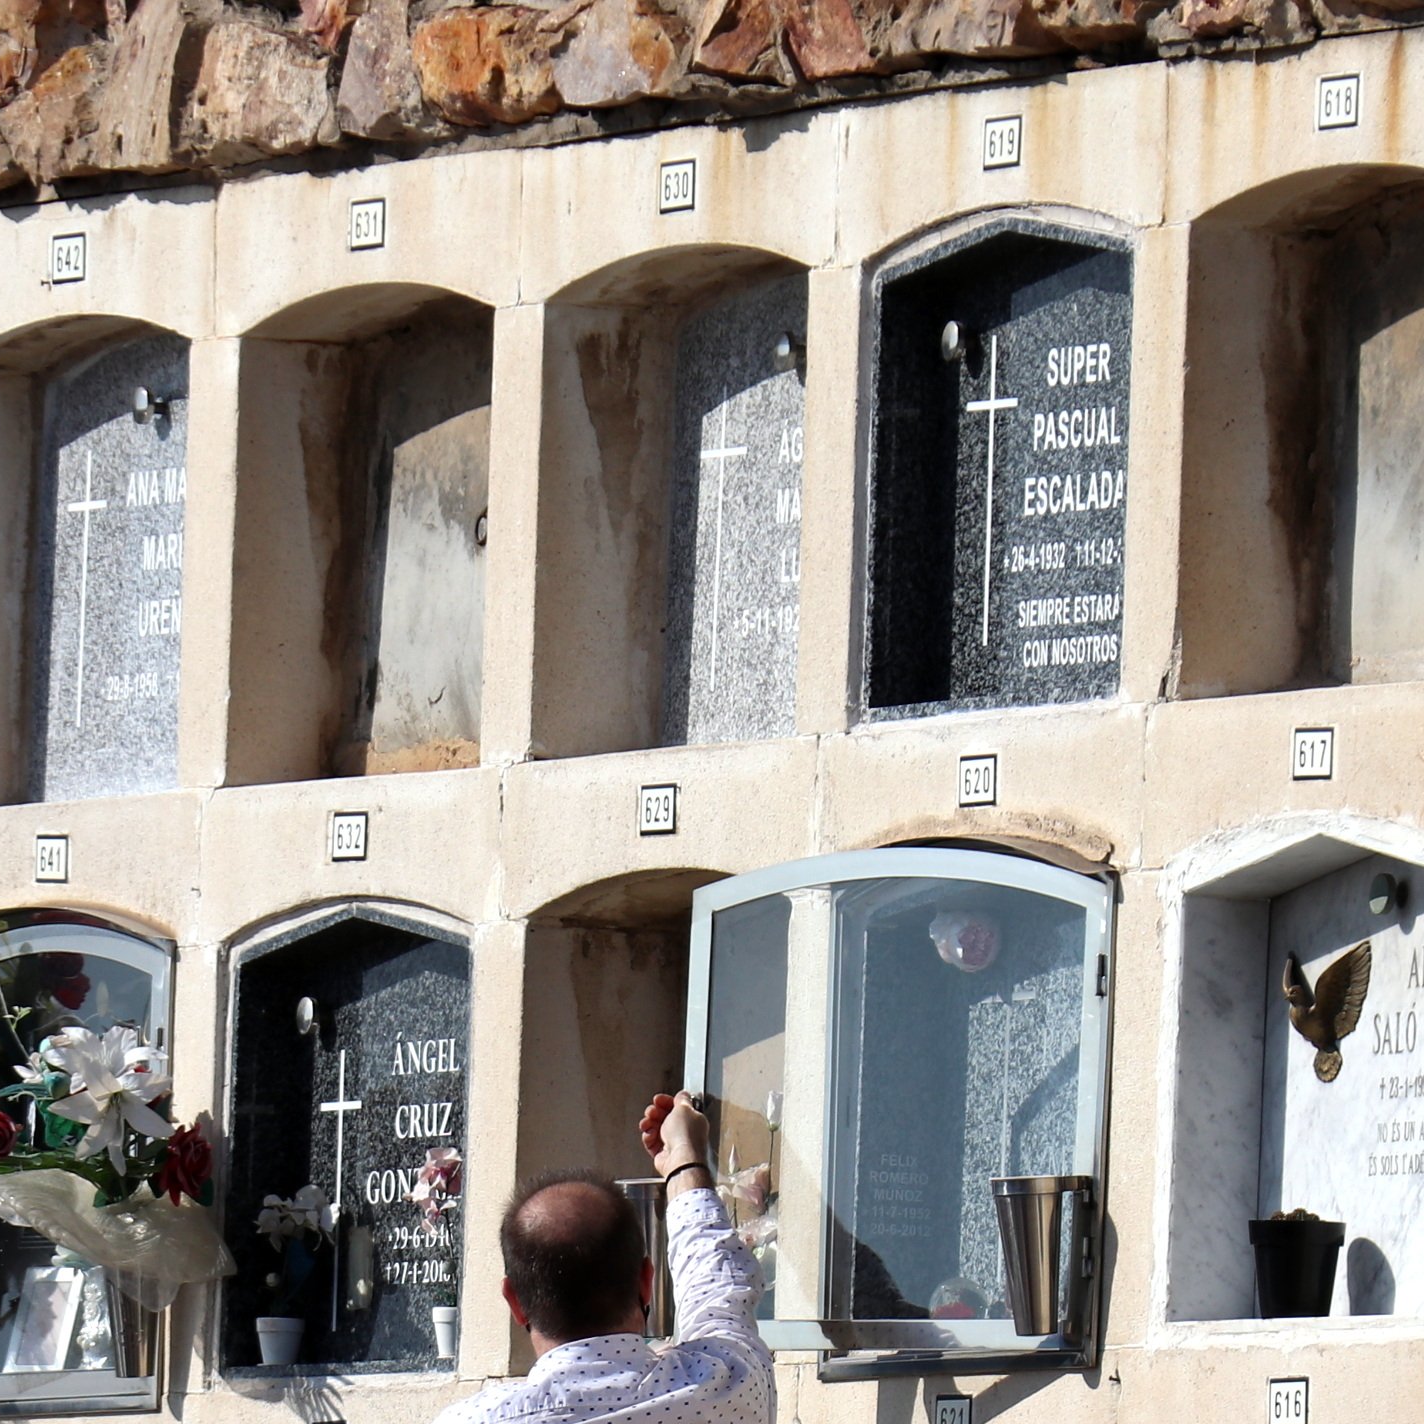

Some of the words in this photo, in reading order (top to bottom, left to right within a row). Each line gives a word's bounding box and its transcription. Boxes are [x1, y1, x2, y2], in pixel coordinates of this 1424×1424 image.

[1324, 86, 1352, 117] 618
[989, 126, 1015, 158] 619
[664, 171, 690, 201] 630
[355, 210, 378, 240] 631
[56, 245, 81, 272] 642
[1047, 342, 1110, 387] SUPER
[1033, 407, 1121, 451] PASCUAL
[126, 471, 159, 506] ANA
[1024, 471, 1124, 516] ESCALADA
[1018, 596, 1070, 627] SIEMPRE
[1074, 586, 1120, 622] ESTARÁ
[1023, 641, 1049, 666] CON
[1052, 635, 1117, 665] NOSOTROS
[1299, 739, 1327, 768] 617
[964, 767, 990, 796] 620
[645, 795, 670, 824] 629
[337, 822, 362, 850] 632
[39, 846, 62, 873] 641
[1373, 1002, 1417, 1056] SALÓ
[391, 1034, 459, 1074] ÁNGEL
[395, 1103, 452, 1138] CRUZ
[1404, 1122, 1415, 1141] UN
[1274, 1390, 1302, 1419] 616
